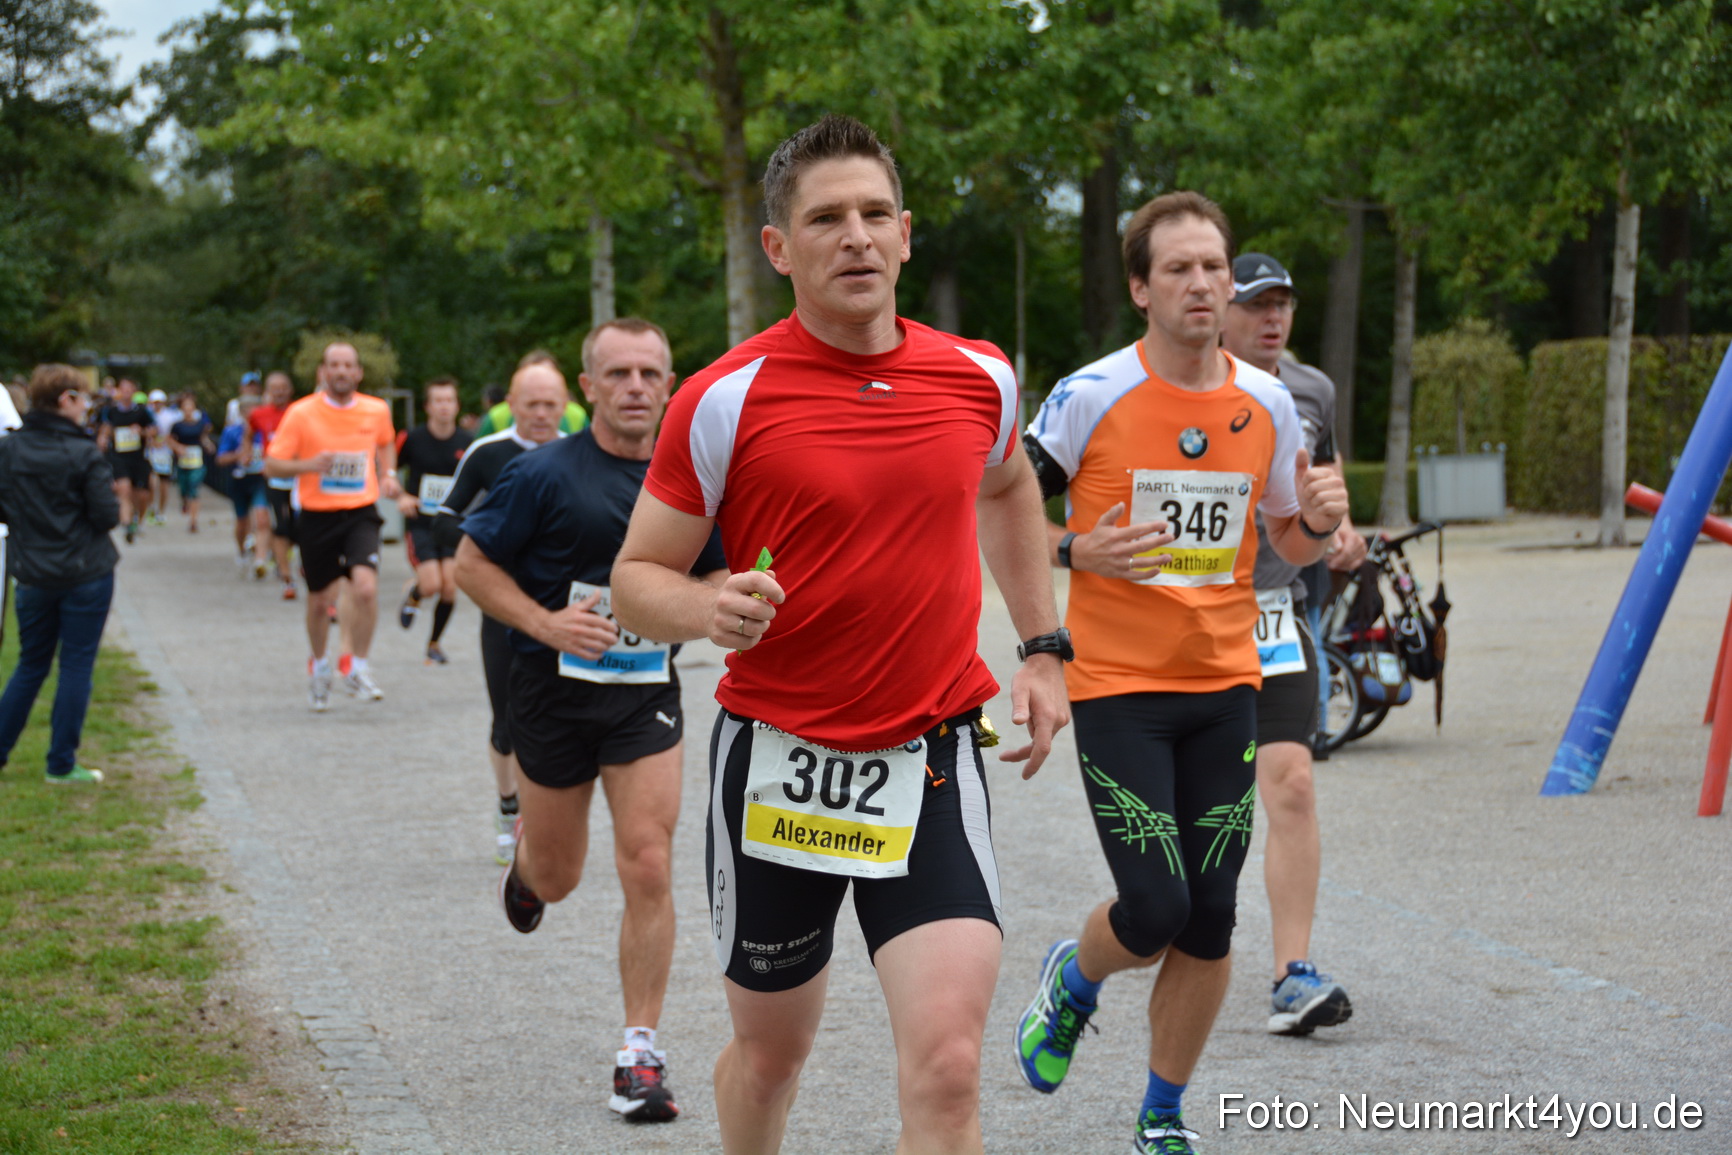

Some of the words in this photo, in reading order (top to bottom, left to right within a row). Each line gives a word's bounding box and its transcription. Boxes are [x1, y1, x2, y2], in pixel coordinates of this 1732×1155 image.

[1136, 482, 1178, 494] PARTL
[1181, 483, 1234, 495] Neumarkt
[1160, 500, 1229, 542] 346
[597, 655, 636, 670] Klaus
[783, 747, 889, 816] 302
[772, 817, 885, 856] Alexander
[742, 940, 783, 951] SPORT
[787, 928, 821, 949] STADL
